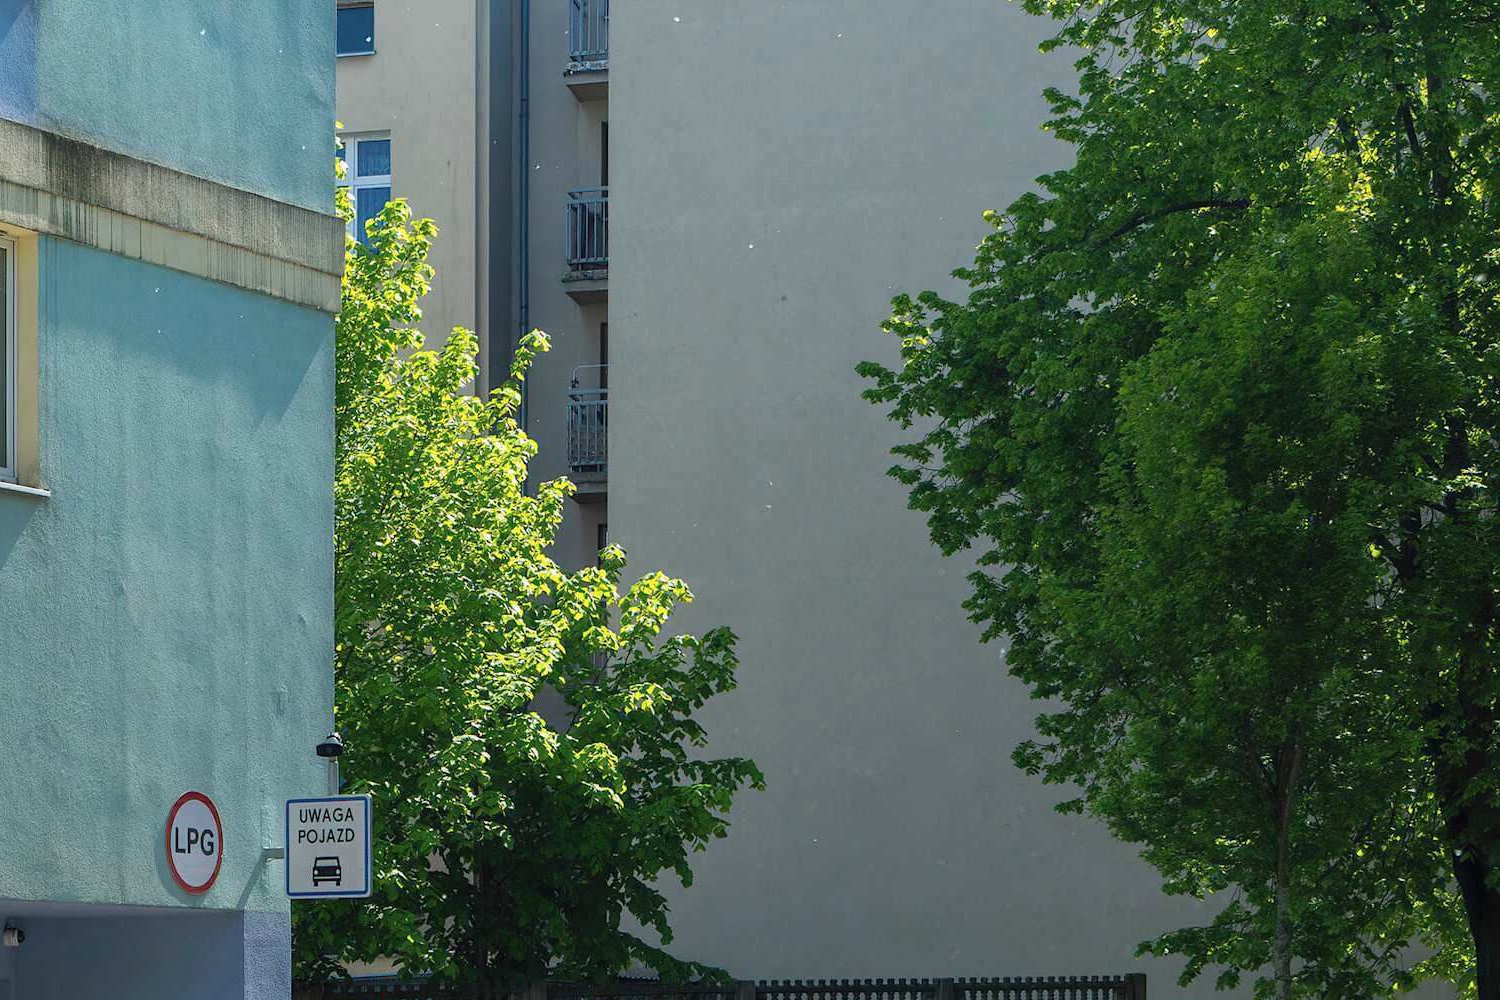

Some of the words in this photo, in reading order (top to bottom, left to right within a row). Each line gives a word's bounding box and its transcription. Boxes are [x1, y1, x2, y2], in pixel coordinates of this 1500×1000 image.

[299, 807, 354, 824] UWAGA
[175, 827, 214, 856] LPG
[298, 828, 355, 844] POJAZD
